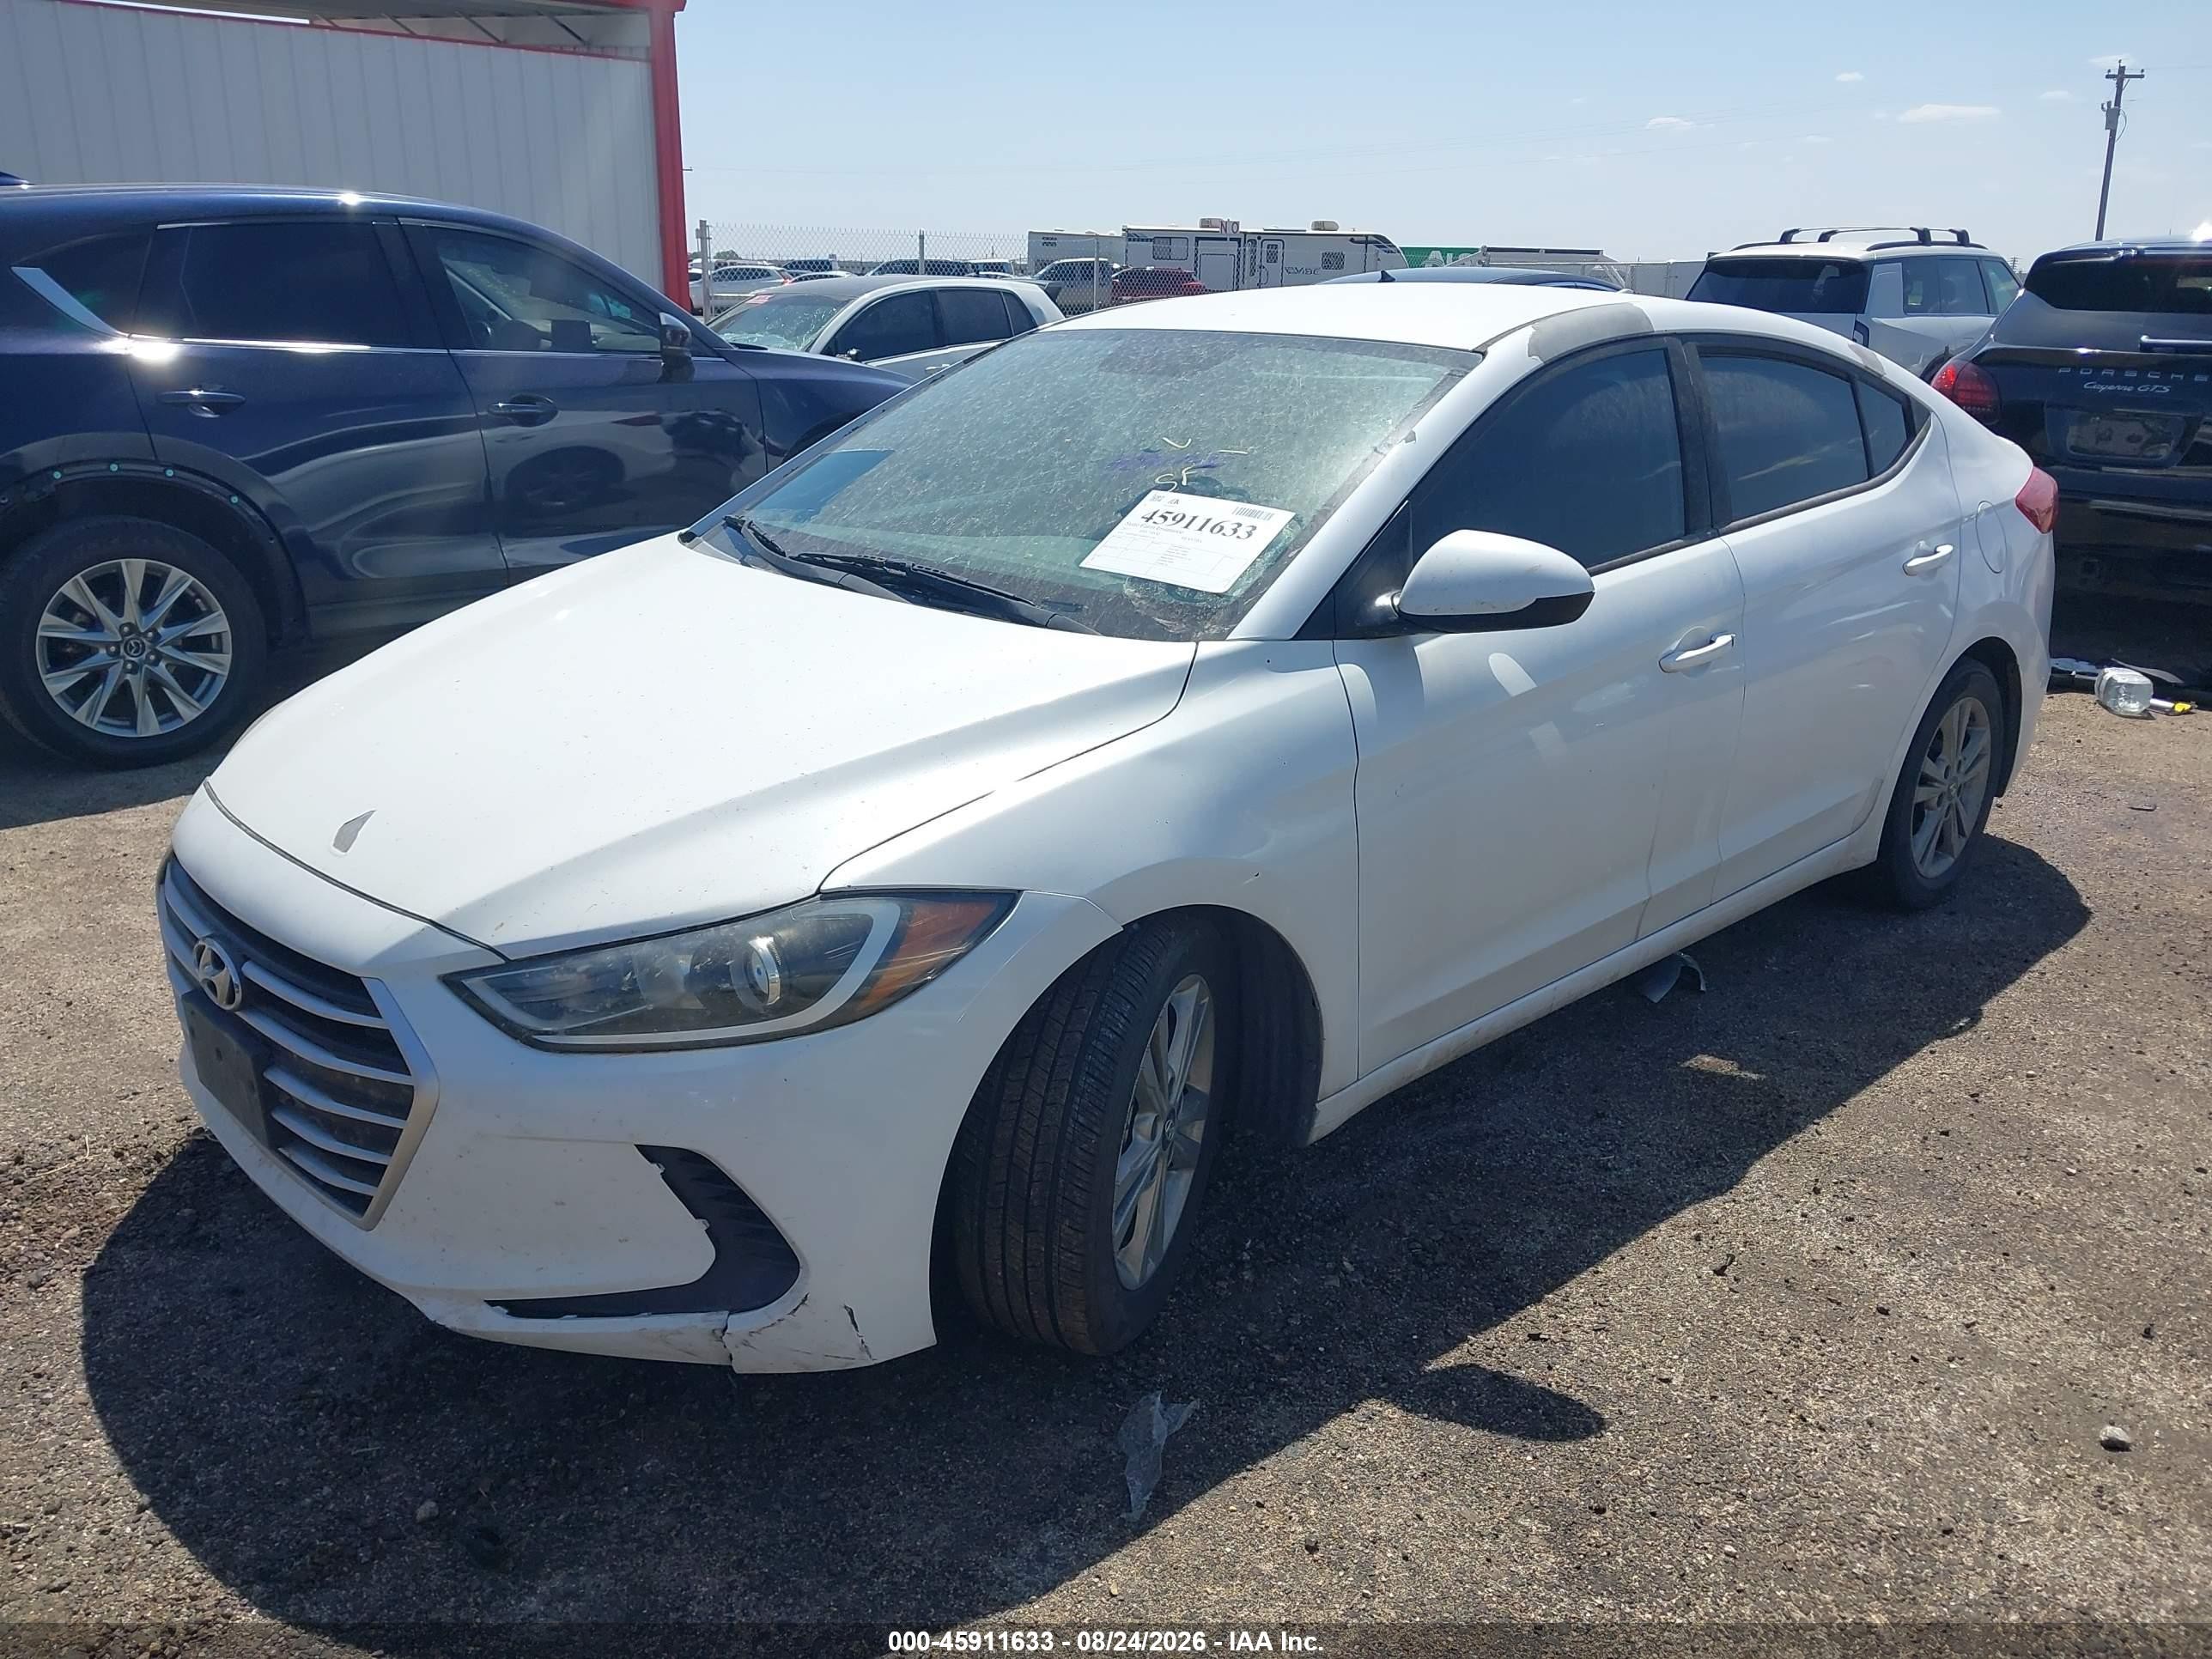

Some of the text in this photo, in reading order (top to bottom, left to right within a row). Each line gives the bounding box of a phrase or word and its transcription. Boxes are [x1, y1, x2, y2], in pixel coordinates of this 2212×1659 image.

[2058, 367, 2209, 381] PORSCHE
[2083, 381, 2134, 392] Cayenne
[1140, 508, 1257, 539] 45911633
